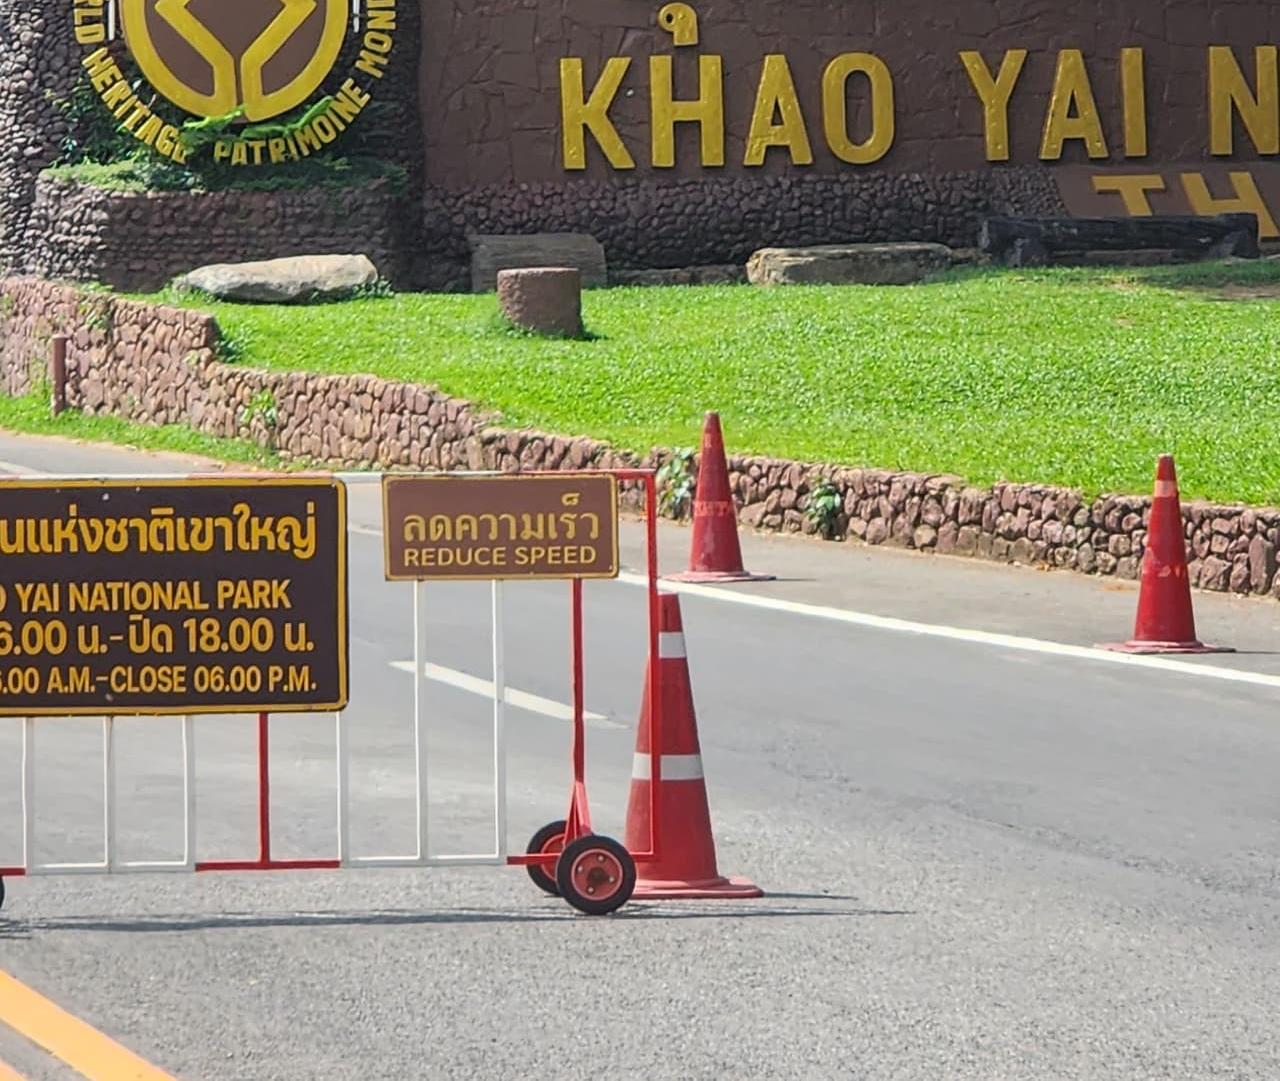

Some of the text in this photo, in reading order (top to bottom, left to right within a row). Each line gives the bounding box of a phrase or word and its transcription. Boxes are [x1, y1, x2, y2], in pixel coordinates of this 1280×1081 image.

[214, 78, 371, 166] PATRIMOINE
[560, 52, 896, 170] KHAO
[959, 46, 1148, 163] YAI
[403, 492, 599, 542] ลดความเร็ว
[403, 545, 597, 567] REDUCE SPEED
[15, 582, 60, 613] YAI
[69, 580, 209, 612] NATIONAL
[217, 578, 292, 610] PARK
[183, 616, 274, 654] 18.00
[284, 621, 315, 653] น.
[193, 664, 262, 693] 06.00
[269, 664, 317, 693] P.M.
